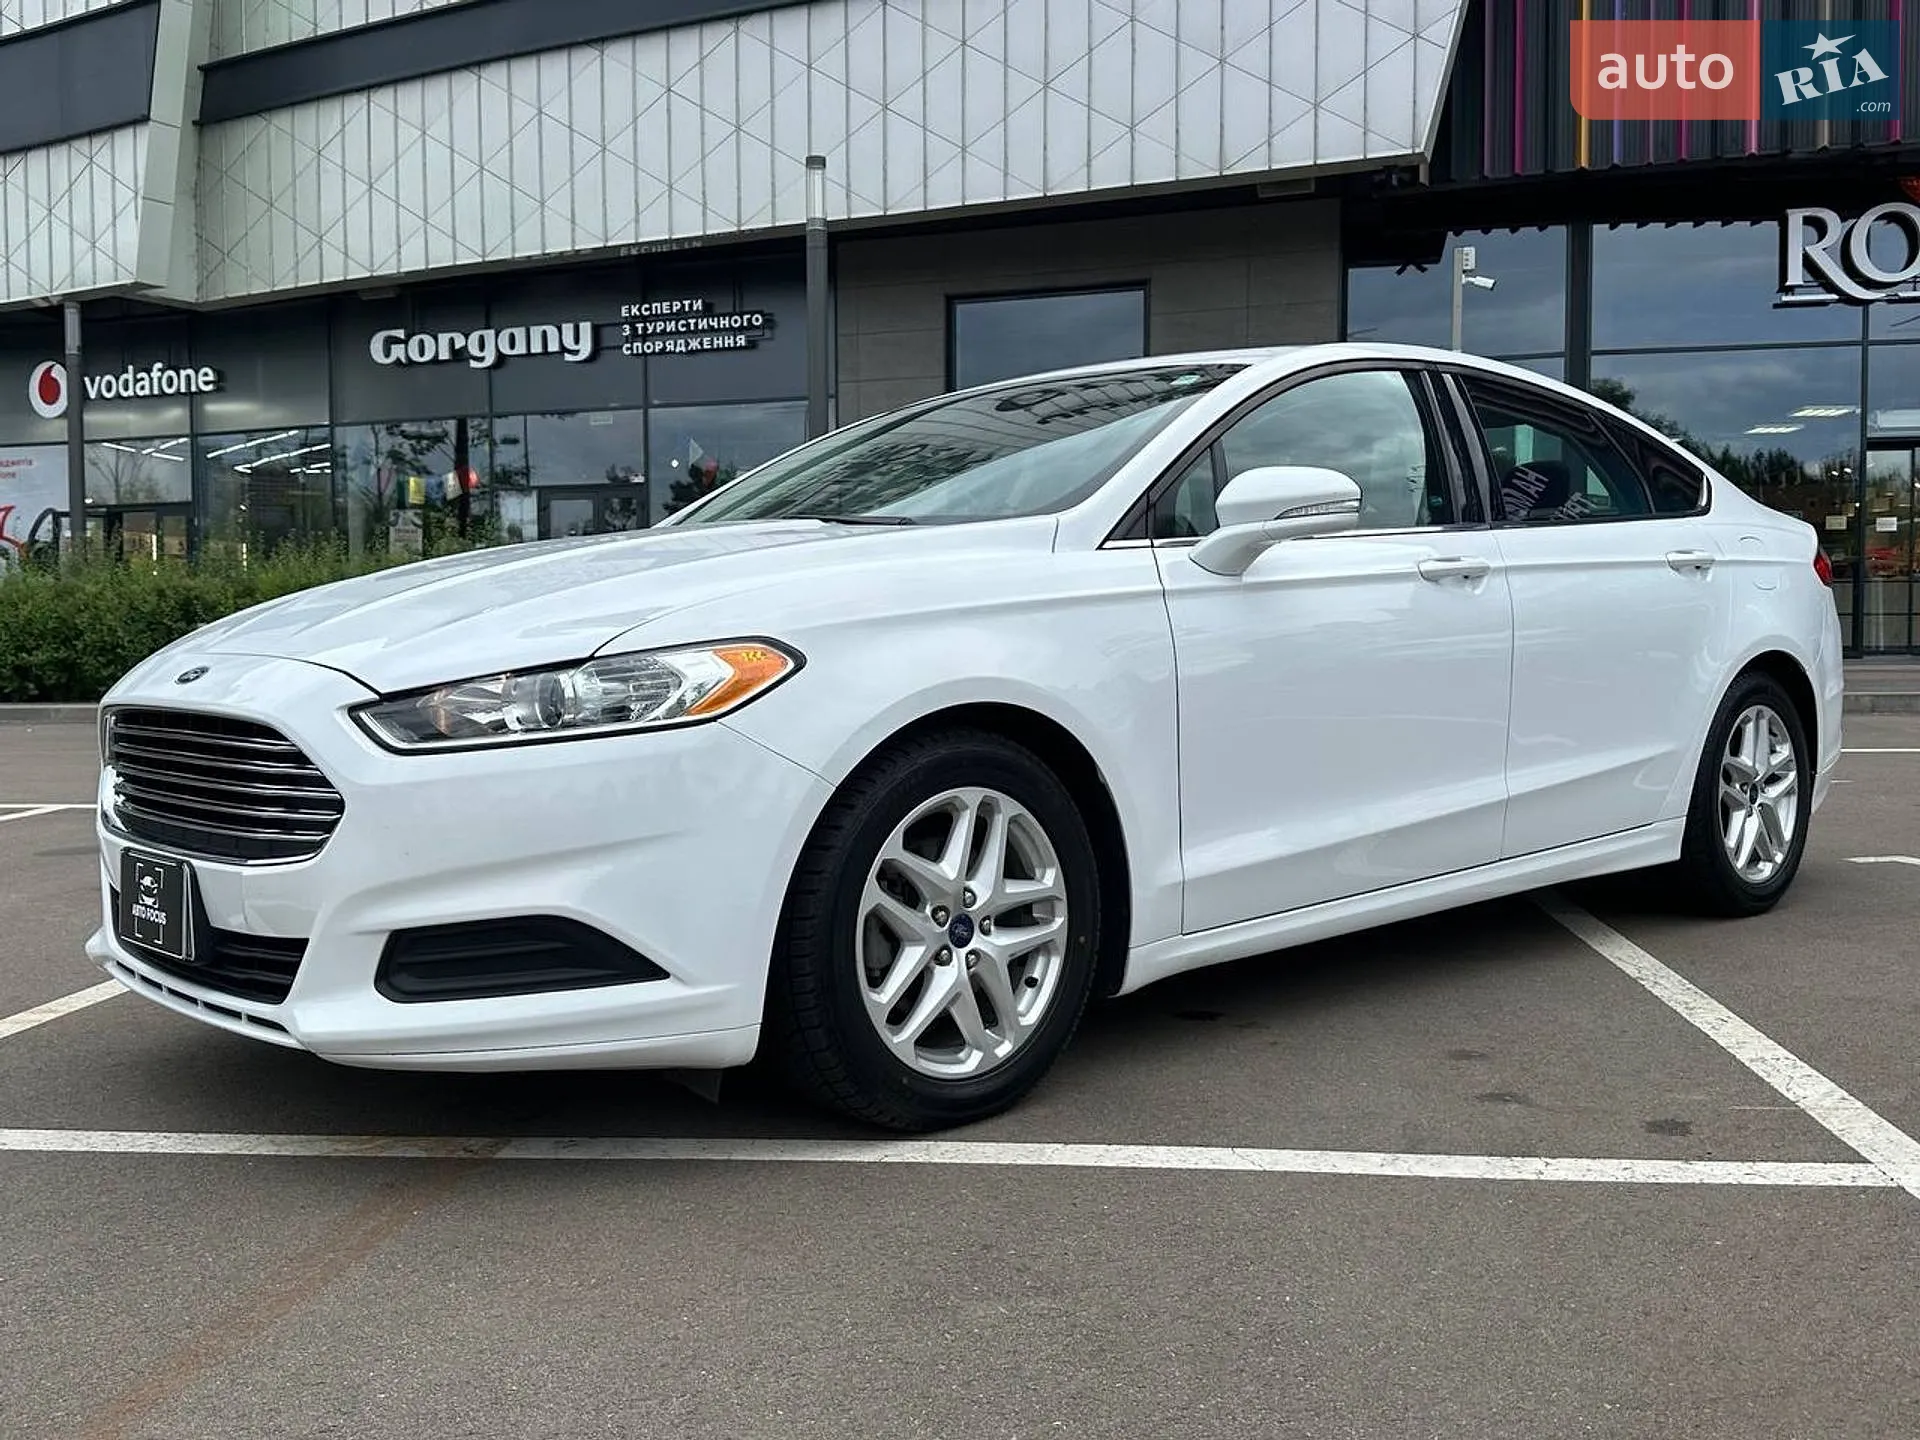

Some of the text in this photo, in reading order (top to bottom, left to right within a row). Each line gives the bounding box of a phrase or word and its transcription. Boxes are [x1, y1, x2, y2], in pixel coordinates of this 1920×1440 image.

[620, 299, 703, 317] ЕКСПЕРТИ
[635, 313, 763, 336] ТУРИСТИЧНОГО
[369, 320, 593, 369] Gorgany
[621, 335, 746, 356] СПОРЯДЖЕННЯ
[83, 361, 217, 400] vodafone
